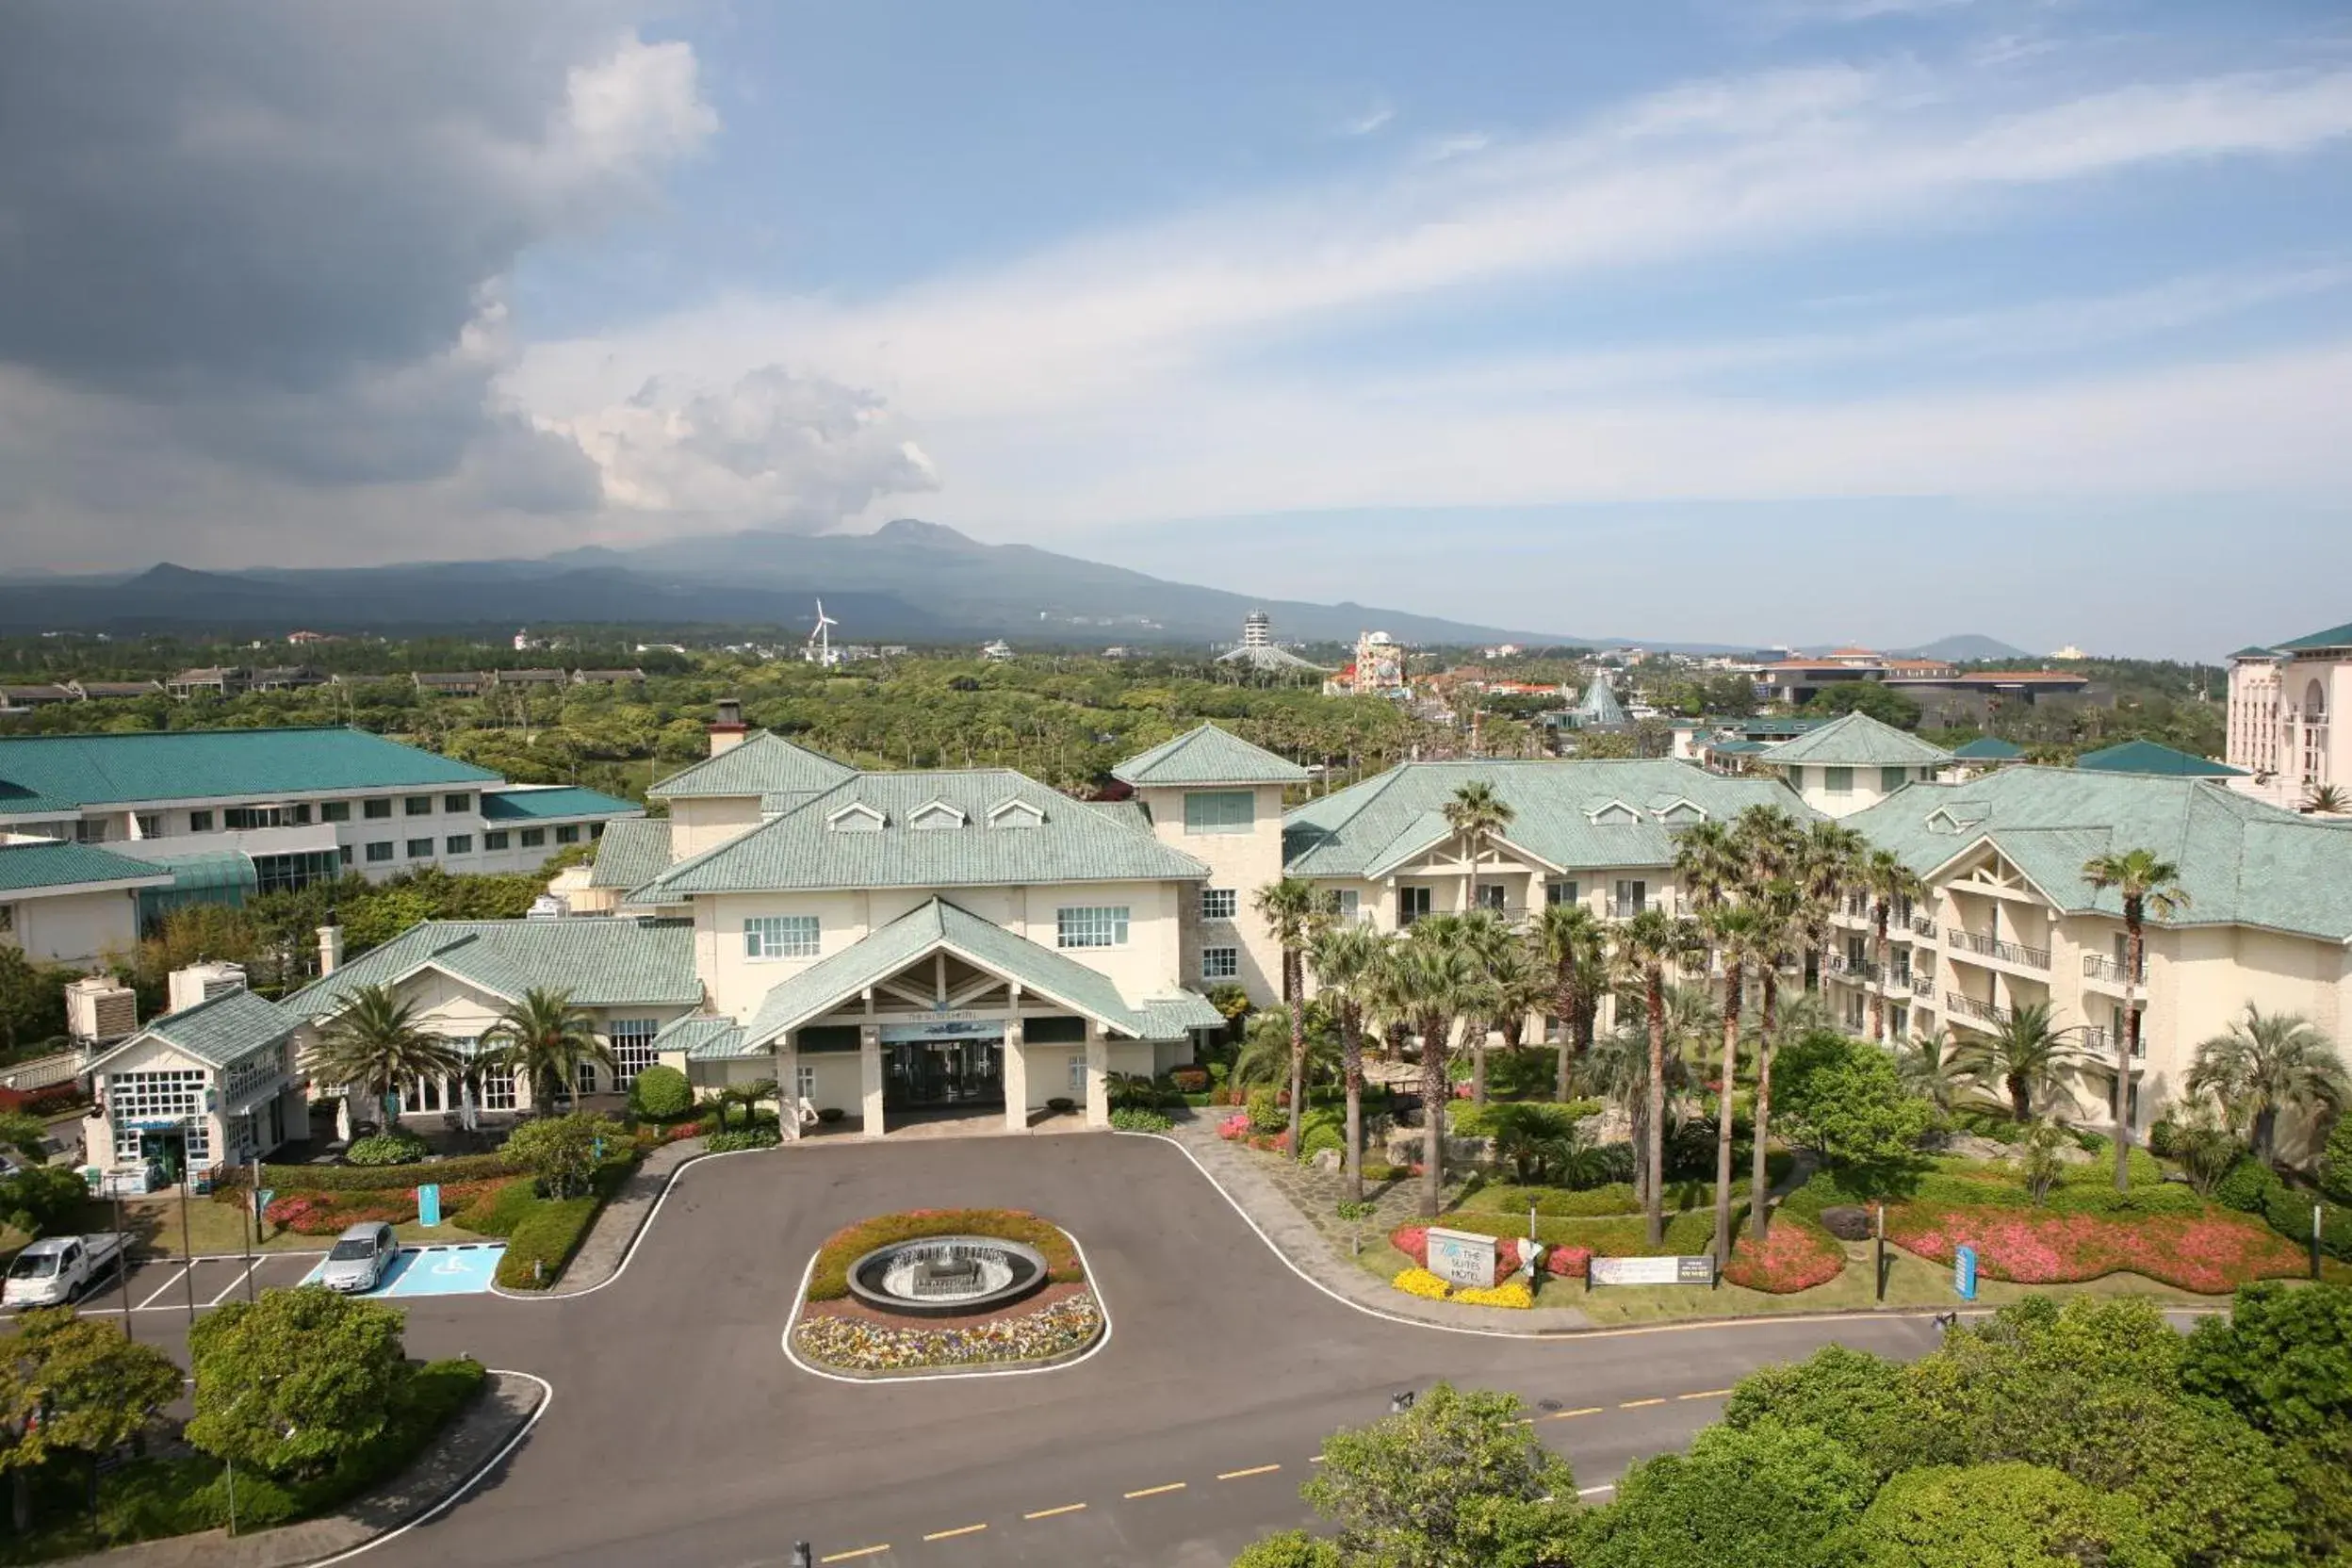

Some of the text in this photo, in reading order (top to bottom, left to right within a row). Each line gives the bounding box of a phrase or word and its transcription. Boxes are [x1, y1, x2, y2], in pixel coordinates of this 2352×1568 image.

[1463, 1250, 1480, 1261] THE
[1451, 1258, 1480, 1271] SUITES
[1451, 1269, 1480, 1282] HOTEL
